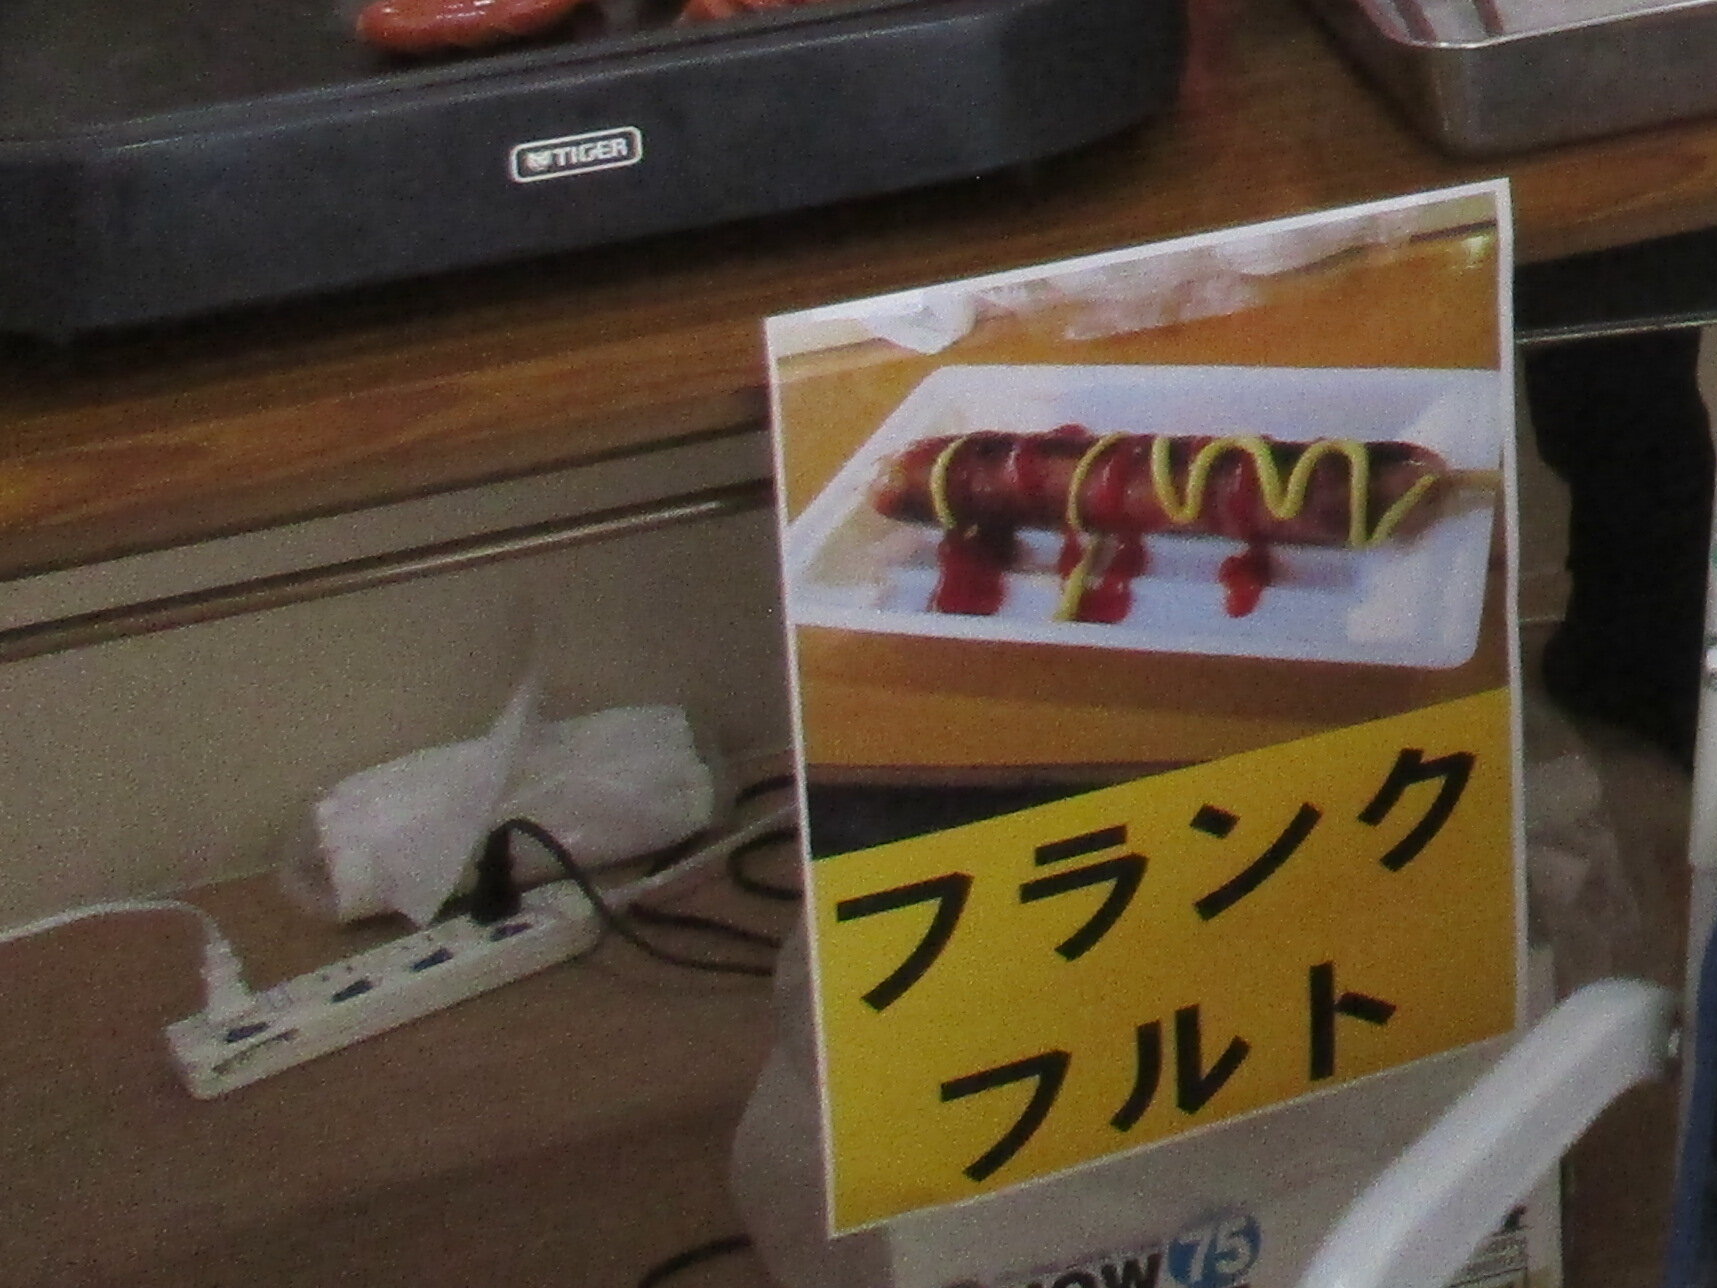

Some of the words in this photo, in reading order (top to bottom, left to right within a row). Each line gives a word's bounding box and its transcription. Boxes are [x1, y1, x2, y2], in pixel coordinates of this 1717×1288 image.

[554, 137, 628, 167] TIGER
[836, 747, 1477, 1011] フランク
[940, 961, 1397, 1182] フルト
